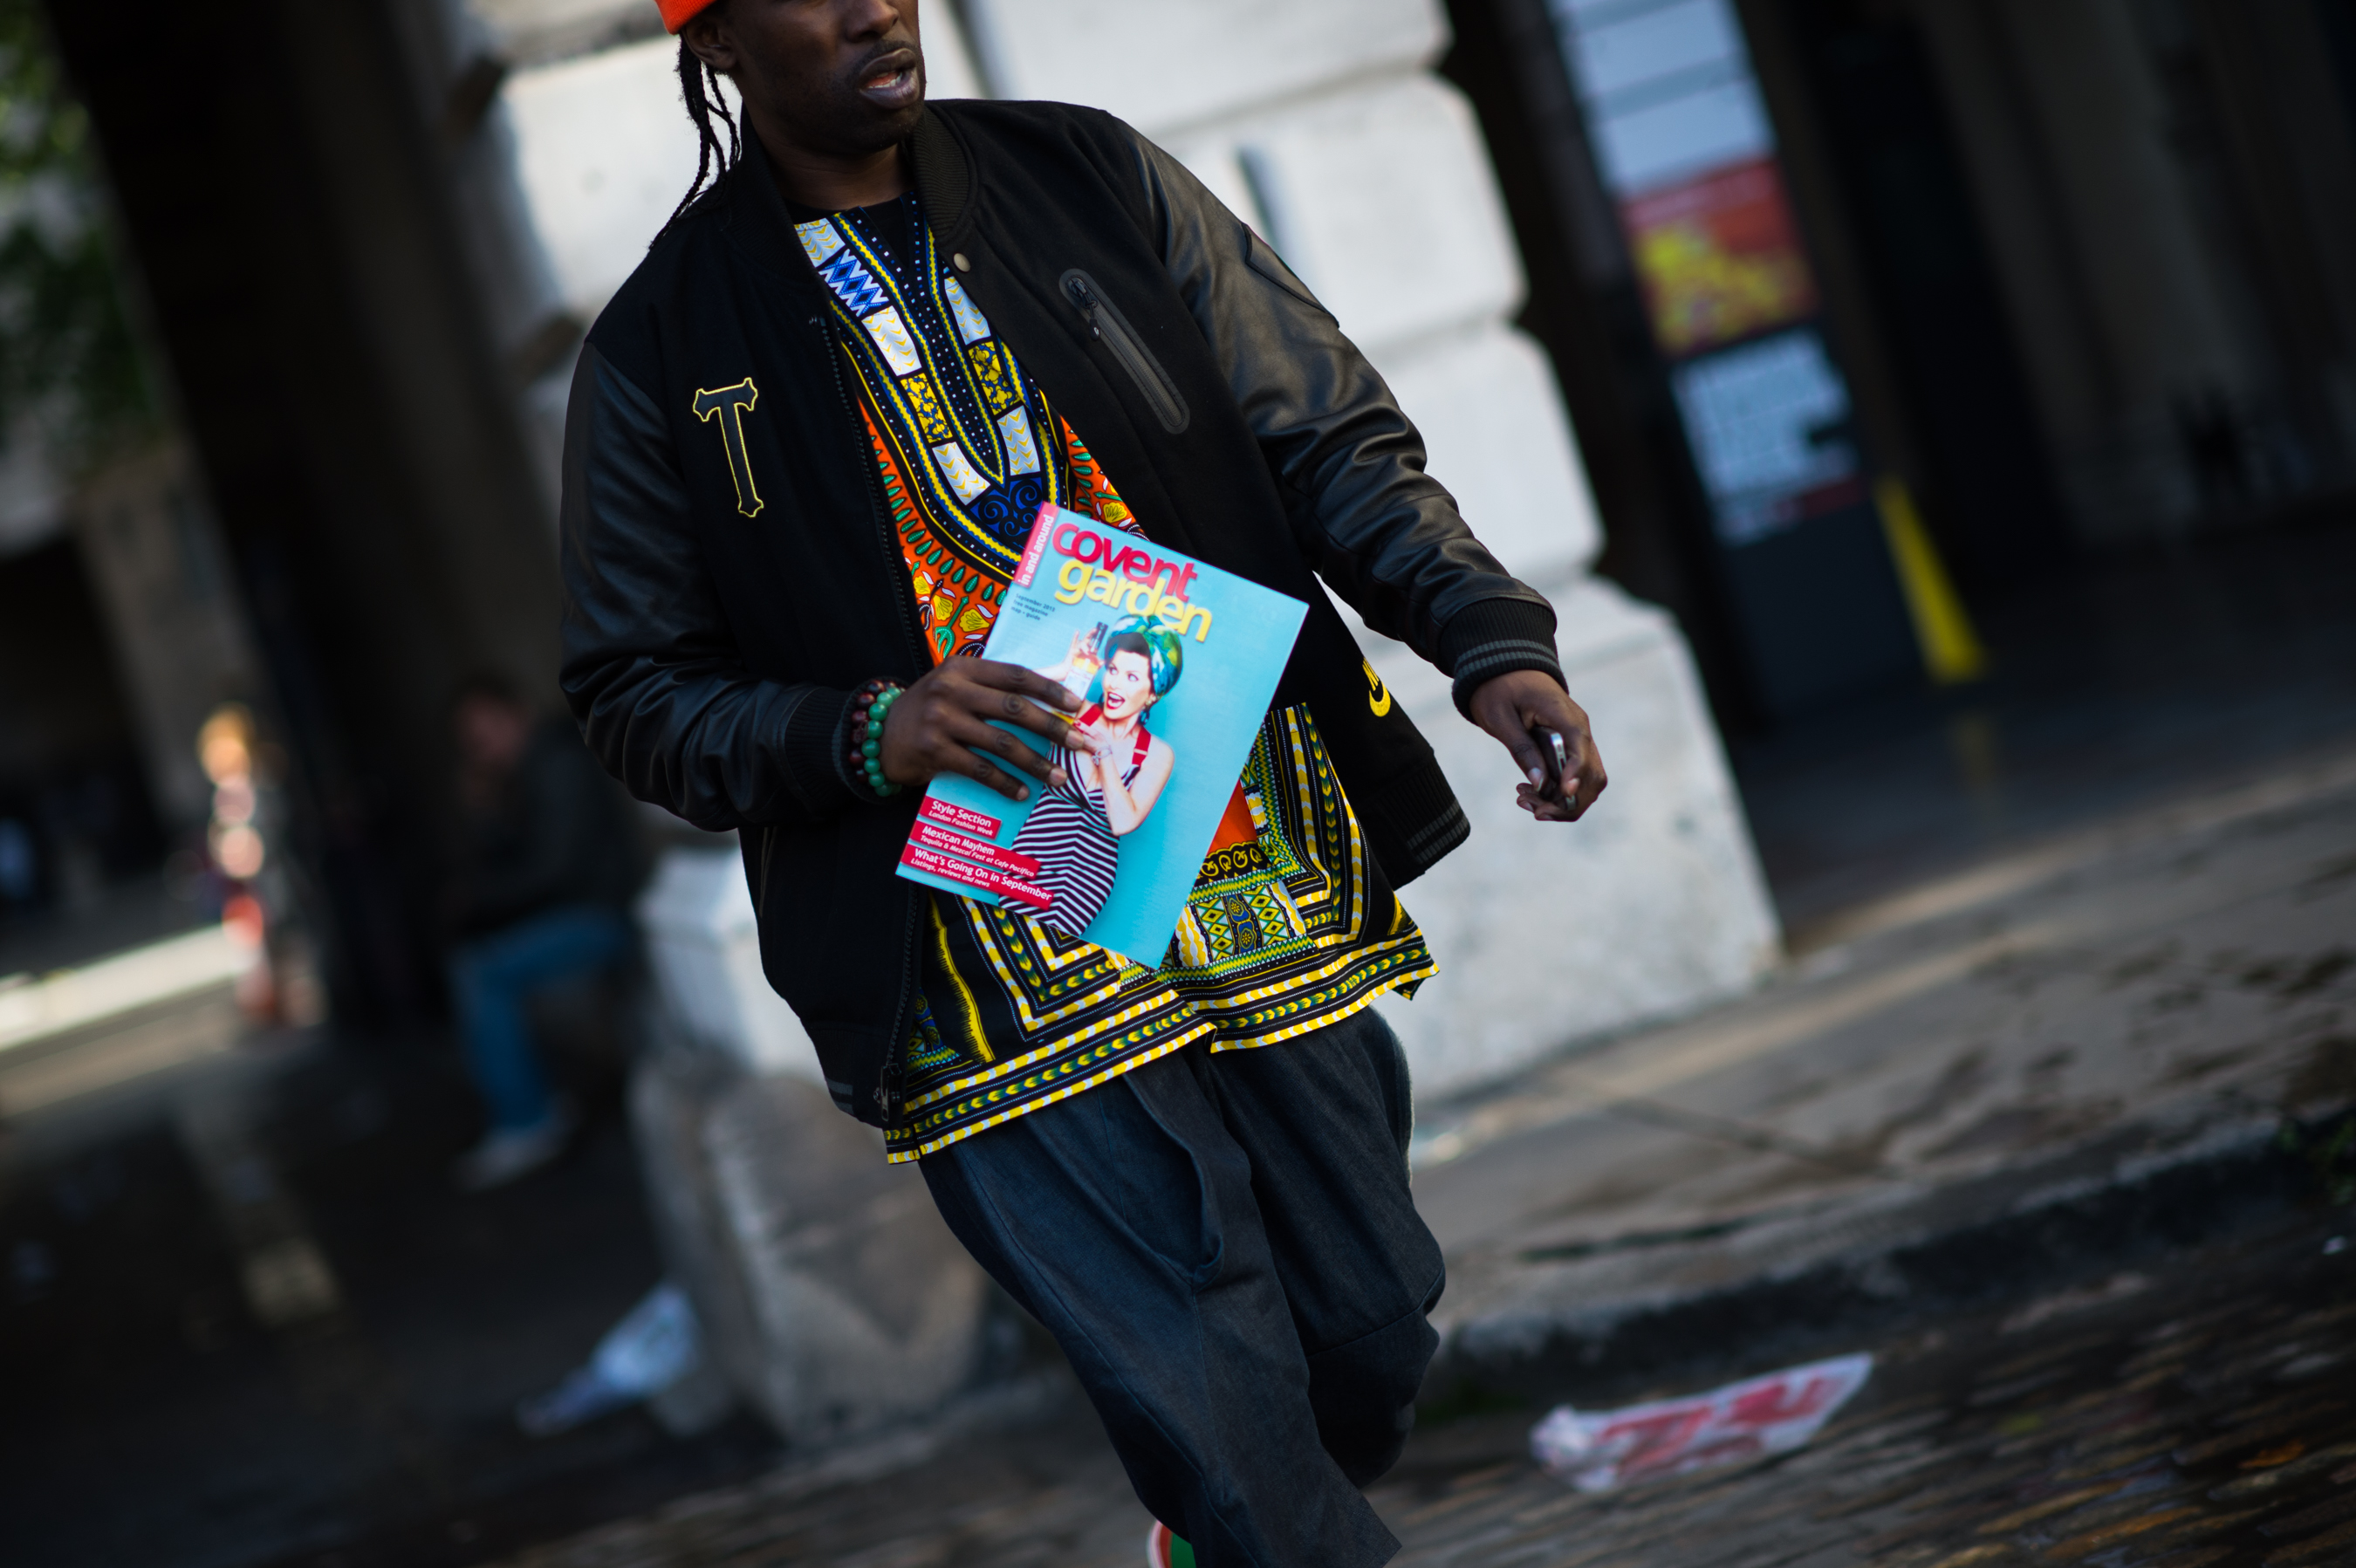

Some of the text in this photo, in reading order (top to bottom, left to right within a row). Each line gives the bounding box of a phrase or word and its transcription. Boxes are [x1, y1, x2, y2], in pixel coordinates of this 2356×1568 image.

[1017, 514, 1054, 585] in and around
[1051, 523, 1198, 602] covent
[1016, 593, 1042, 607] September
[1024, 604, 1048, 616] magazine
[1054, 559, 1213, 643] garden
[928, 811, 993, 836] London Fashion Week
[932, 800, 992, 827] Style Section
[921, 835, 942, 847] Tequila
[949, 845, 971, 856] Mezcal
[971, 852, 985, 860] Fest
[1010, 863, 1034, 877] Pacifico
[922, 825, 995, 856] Mexican Mayhem
[911, 858, 936, 872] Listings,
[937, 867, 962, 879] reviews
[974, 879, 990, 887] news
[915, 848, 1052, 900] What's Going On in September
